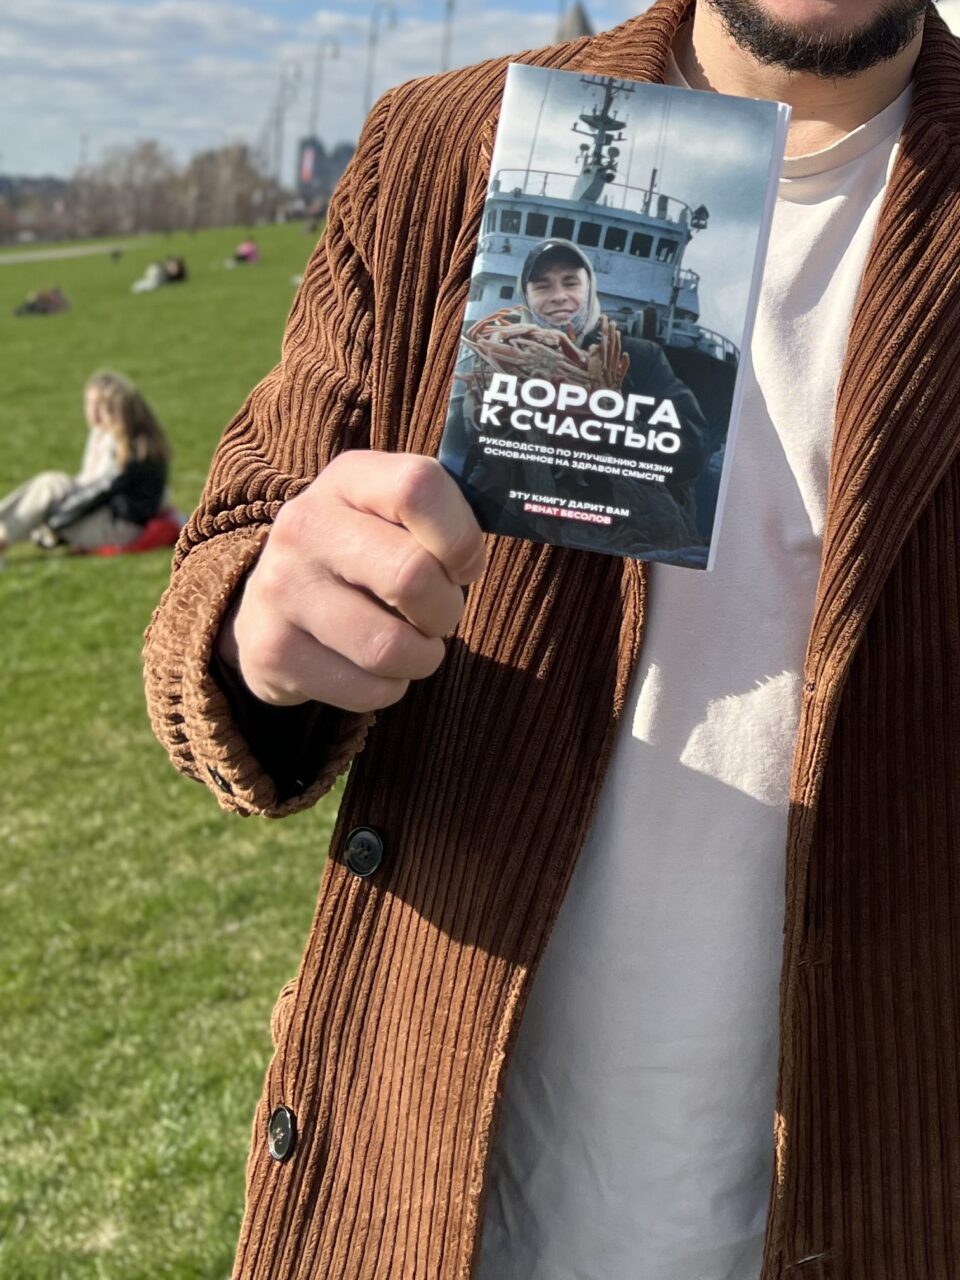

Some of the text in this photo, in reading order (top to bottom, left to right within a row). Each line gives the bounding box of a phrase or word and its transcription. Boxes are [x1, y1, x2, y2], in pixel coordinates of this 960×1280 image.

[483, 372, 681, 429] ДОРОГА
[479, 403, 681, 454] К СЧАСТЬЮ
[478, 436, 673, 474] РУКОВОДСТВО ПО УЛУЧШЕНИЮ ЖИЗНИ
[484, 447, 665, 482] ОСНОВАННОЕ НА ЗДРАВОМ СМЫСЛЕ
[509, 490, 630, 517] ЭТУ КНИГУ ДАРИТ ВАМ
[524, 502, 612, 524] РЕНАТ БЕСОЛОВ
